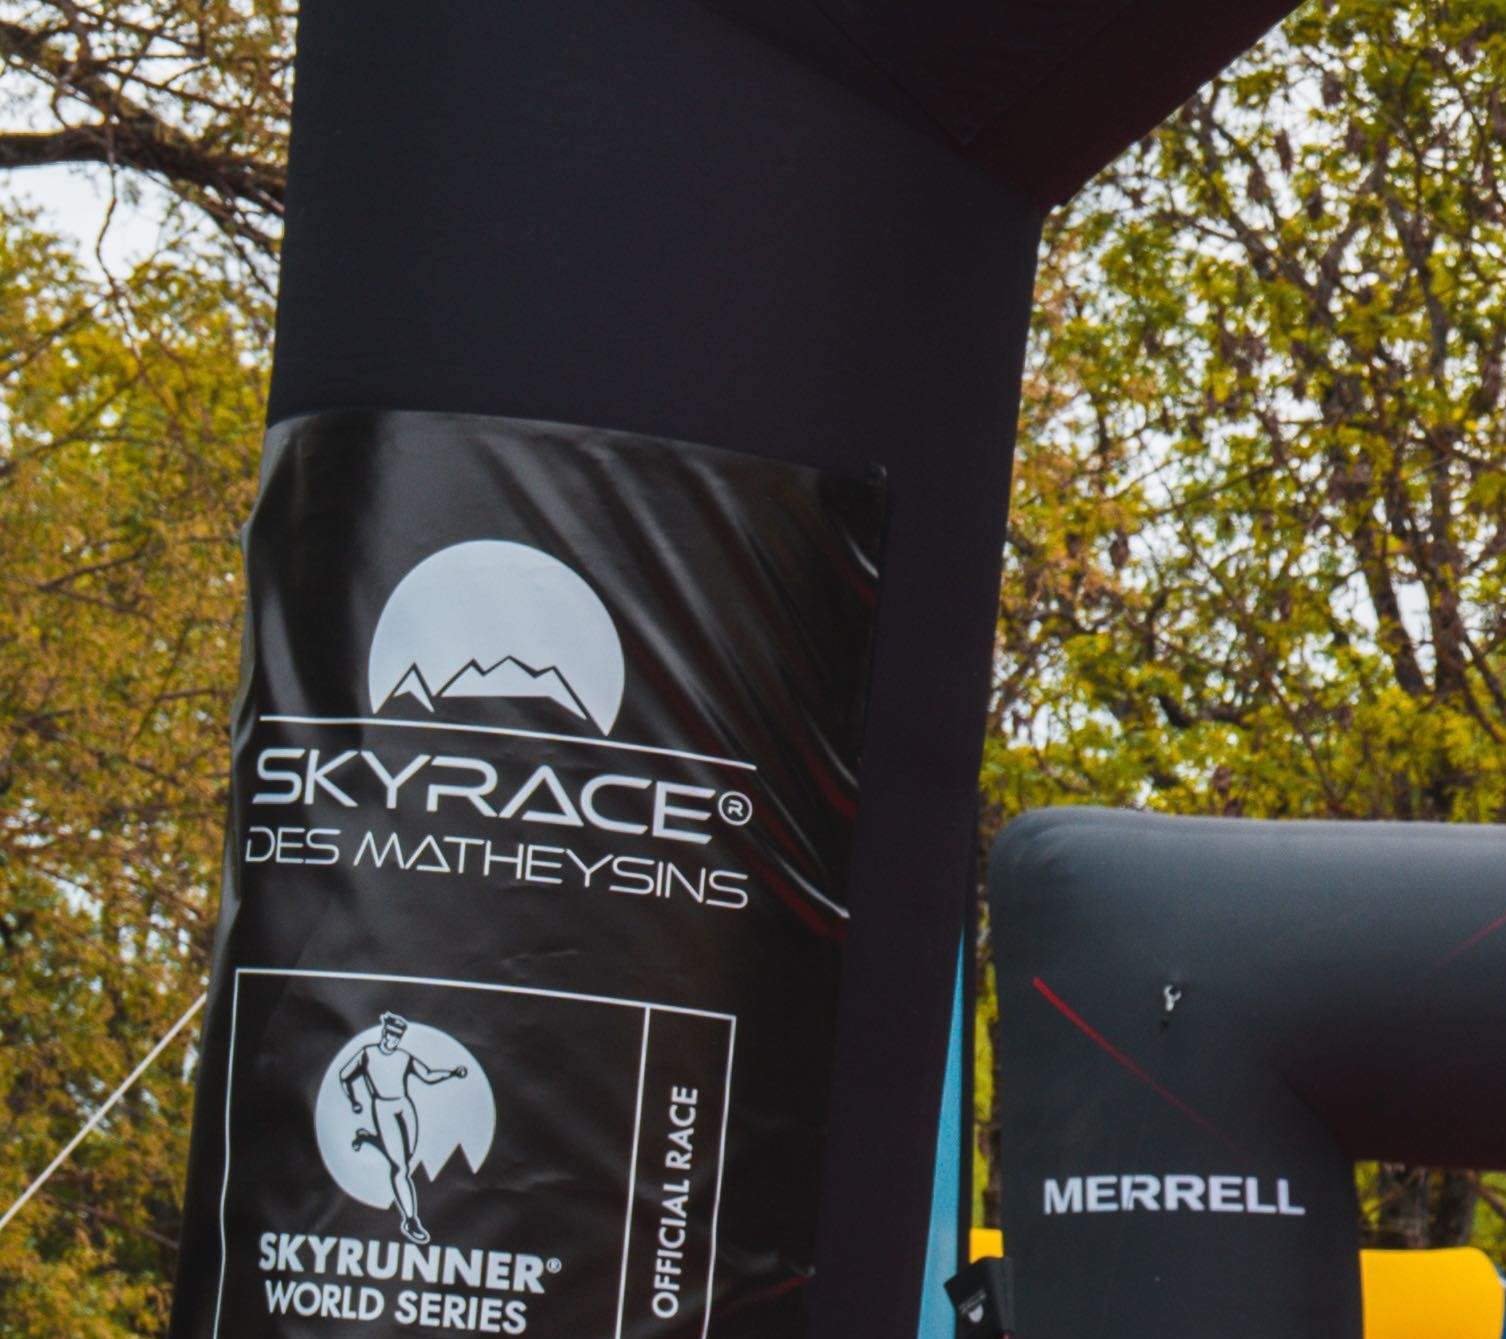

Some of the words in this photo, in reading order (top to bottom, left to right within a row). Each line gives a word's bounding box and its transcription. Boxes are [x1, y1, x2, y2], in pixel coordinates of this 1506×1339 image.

[245, 826, 340, 865] DES
[353, 829, 749, 909] MATHEYSINS
[652, 1178, 691, 1318] OFFICIAL
[675, 1085, 699, 1170] RACE
[1043, 1173, 1306, 1216] MERRELL
[265, 1279, 384, 1320] WORLD
[395, 1288, 526, 1334] SERIES
